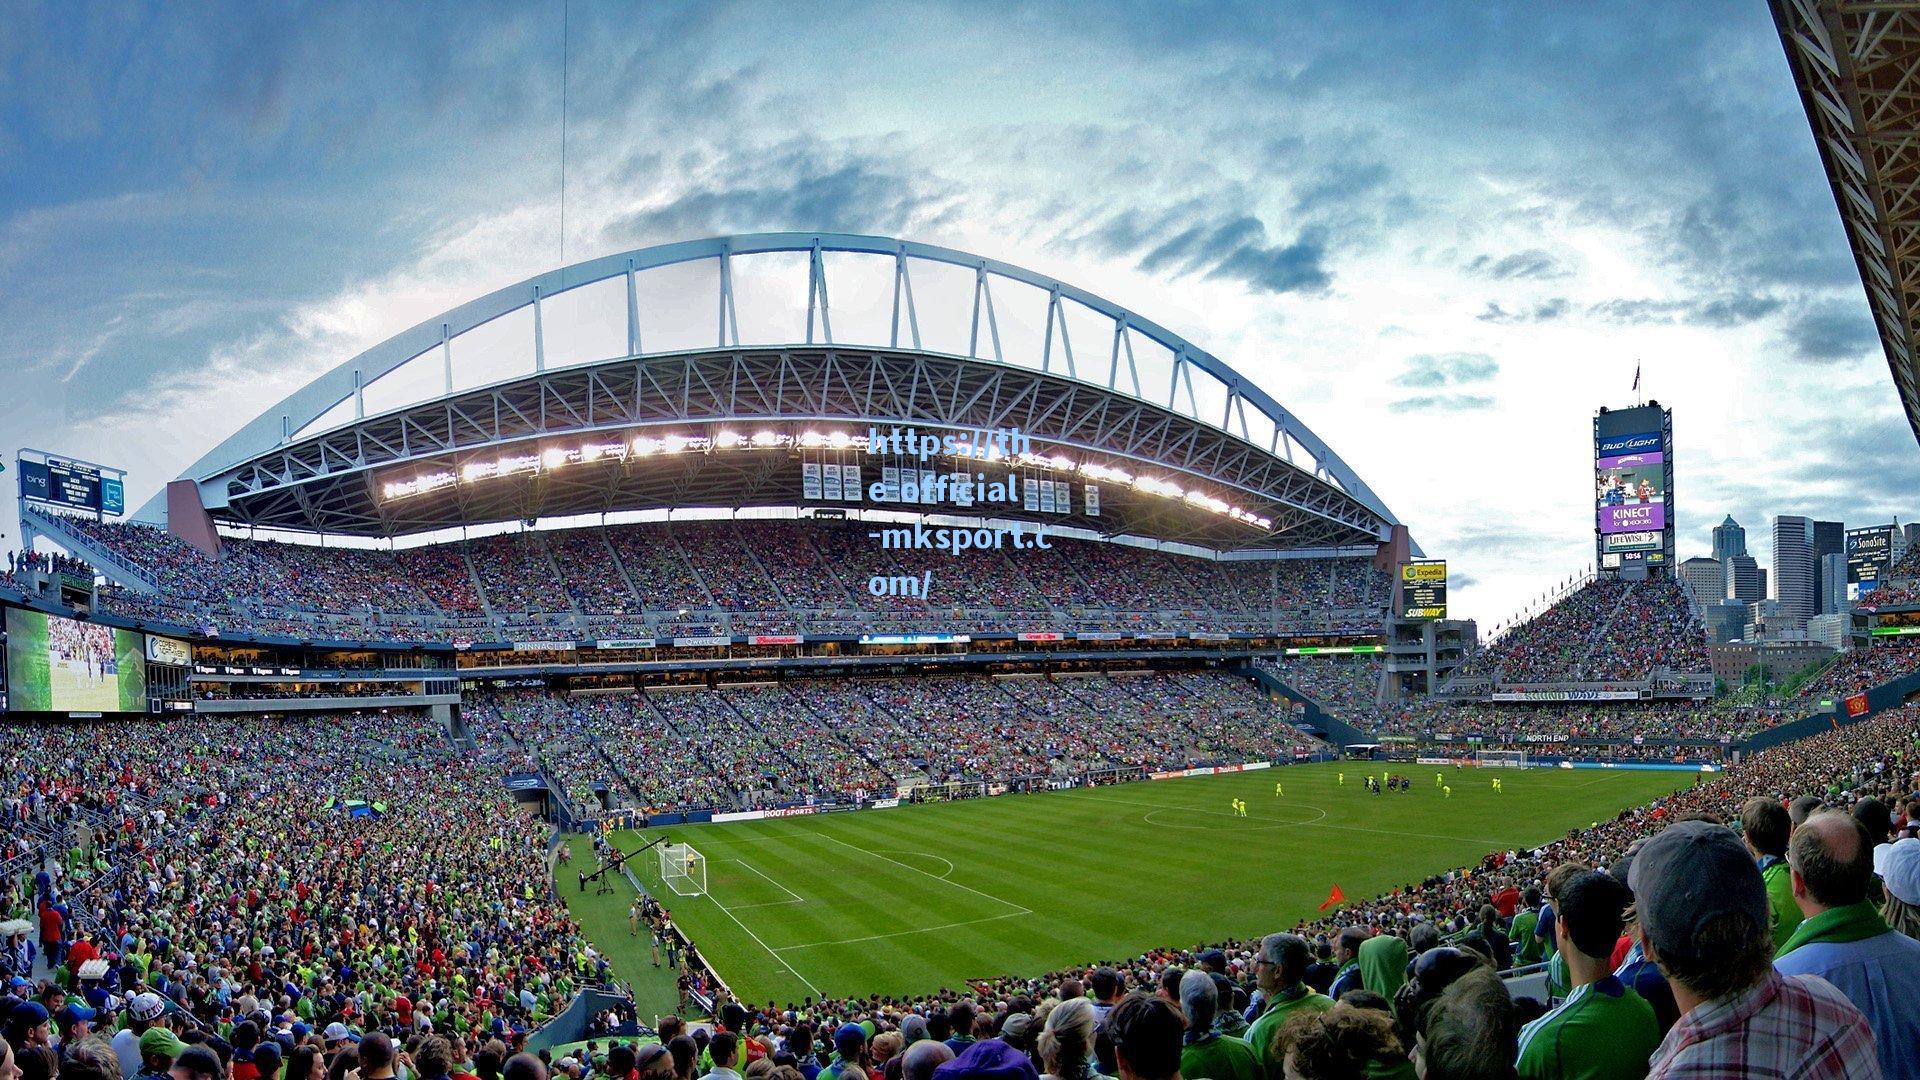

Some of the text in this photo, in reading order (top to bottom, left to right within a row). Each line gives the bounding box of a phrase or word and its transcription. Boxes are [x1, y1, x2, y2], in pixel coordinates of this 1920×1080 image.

[1602, 438, 1658, 451] BUD LIGHT
[26, 474, 46, 487] bing
[1613, 507, 1652, 519] KINECT
[1858, 536, 1886, 549] SonoSite
[1417, 569, 1442, 577] Expedia
[1405, 608, 1445, 618] SUBWAY
[519, 642, 565, 651] PINNACLE
[685, 638, 709, 646] Qwest
[1526, 734, 1552, 742] NORTH
[764, 808, 813, 818] ROOT SPORTS
